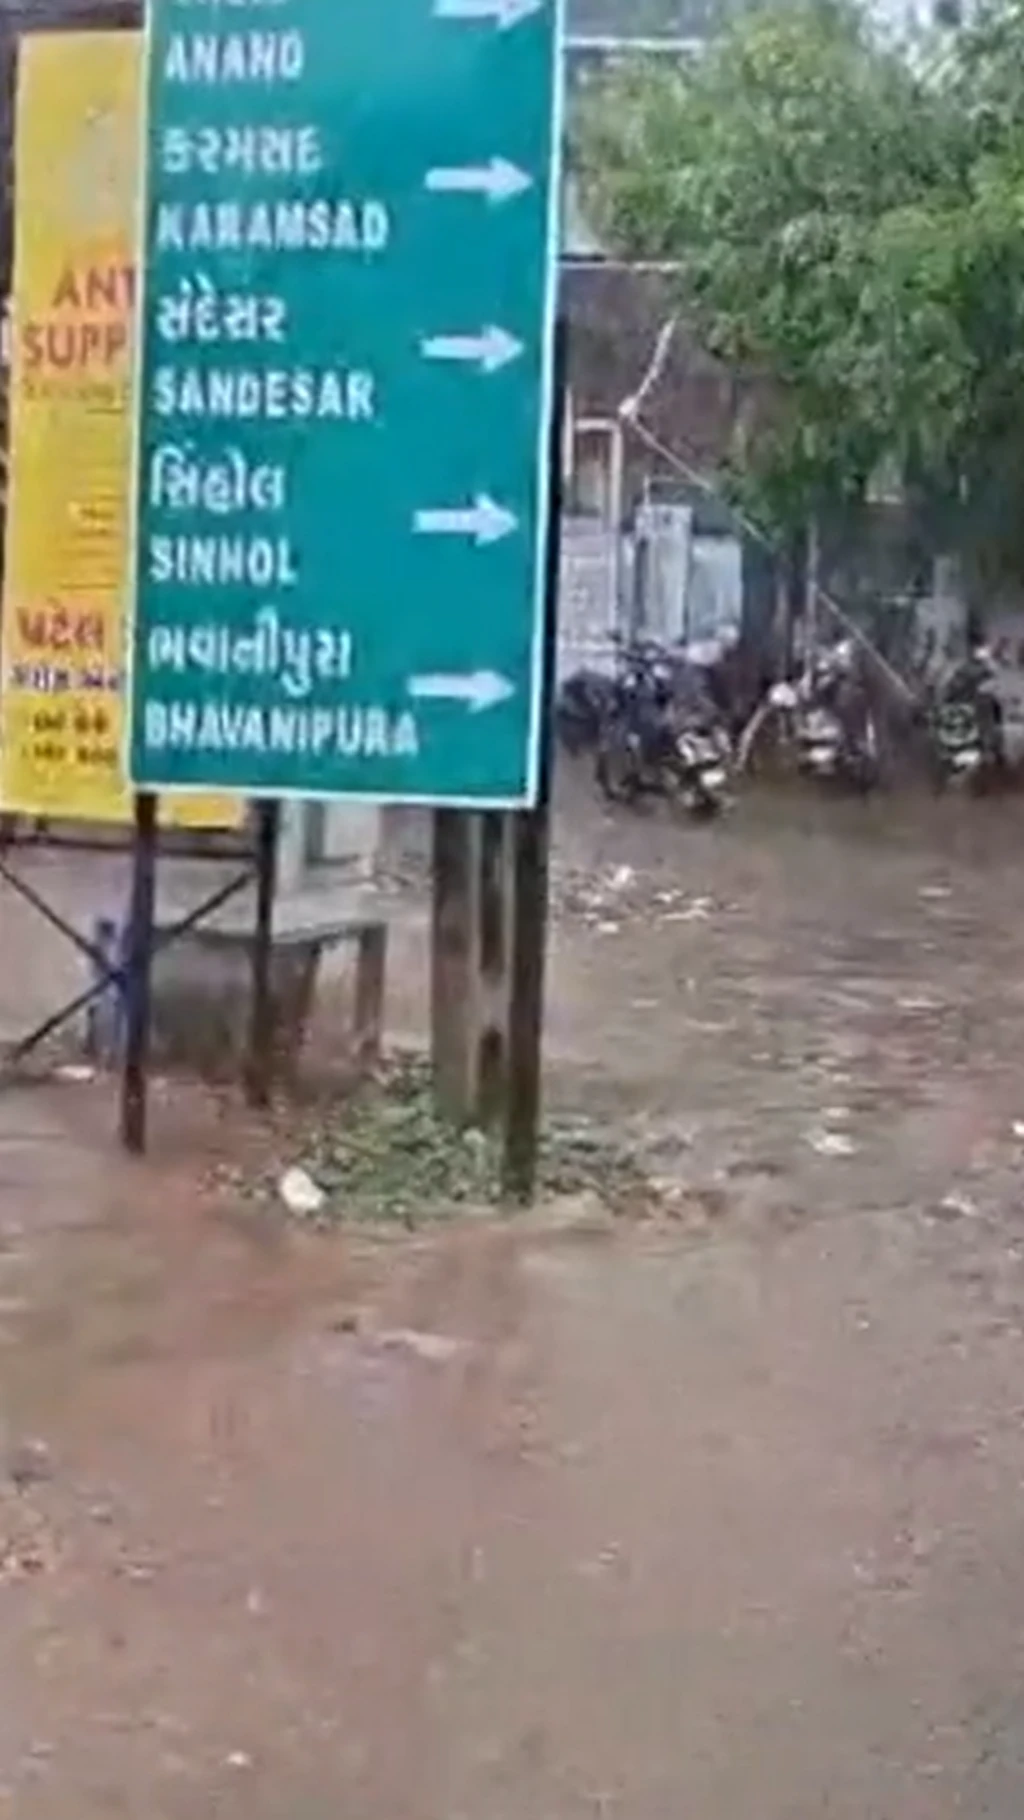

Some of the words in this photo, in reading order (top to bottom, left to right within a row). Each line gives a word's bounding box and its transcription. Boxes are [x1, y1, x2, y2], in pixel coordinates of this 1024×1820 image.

[156, 200, 388, 250] KARAMSAD
[156, 272, 286, 342] સંદેસર
[153, 366, 374, 421] SANDESAR
[150, 536, 297, 586] SINHOL
[145, 699, 418, 756] BHAVANIPURA
